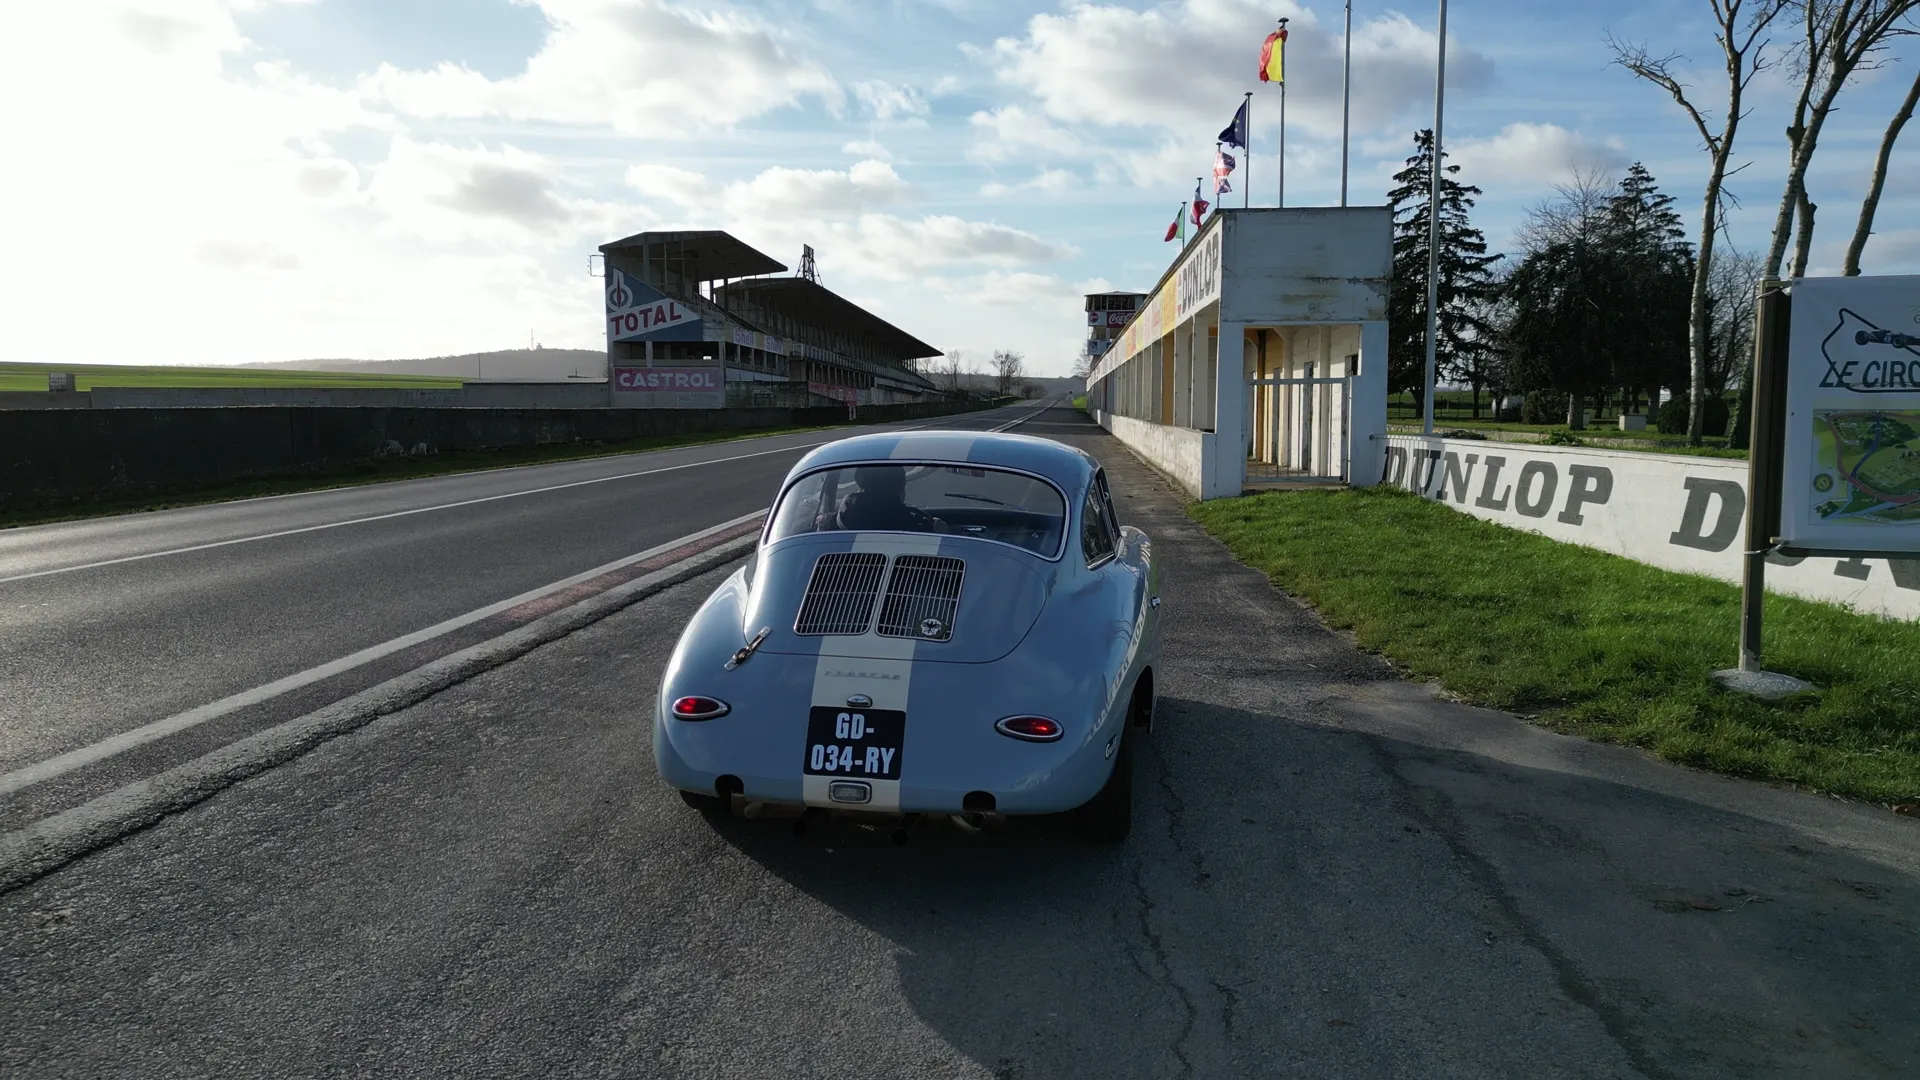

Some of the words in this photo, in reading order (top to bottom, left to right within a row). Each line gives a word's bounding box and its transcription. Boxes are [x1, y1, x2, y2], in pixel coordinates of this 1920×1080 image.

[1182, 231, 1219, 313] DUNLOP
[611, 302, 682, 336] TOTAL
[735, 329, 754, 347] Shell
[619, 373, 715, 388] CASTROL
[1818, 360, 1859, 388] LE
[1381, 446, 1614, 527] DUNLOP
[835, 712, 875, 740] GD-
[810, 744, 895, 774] 034-RY
